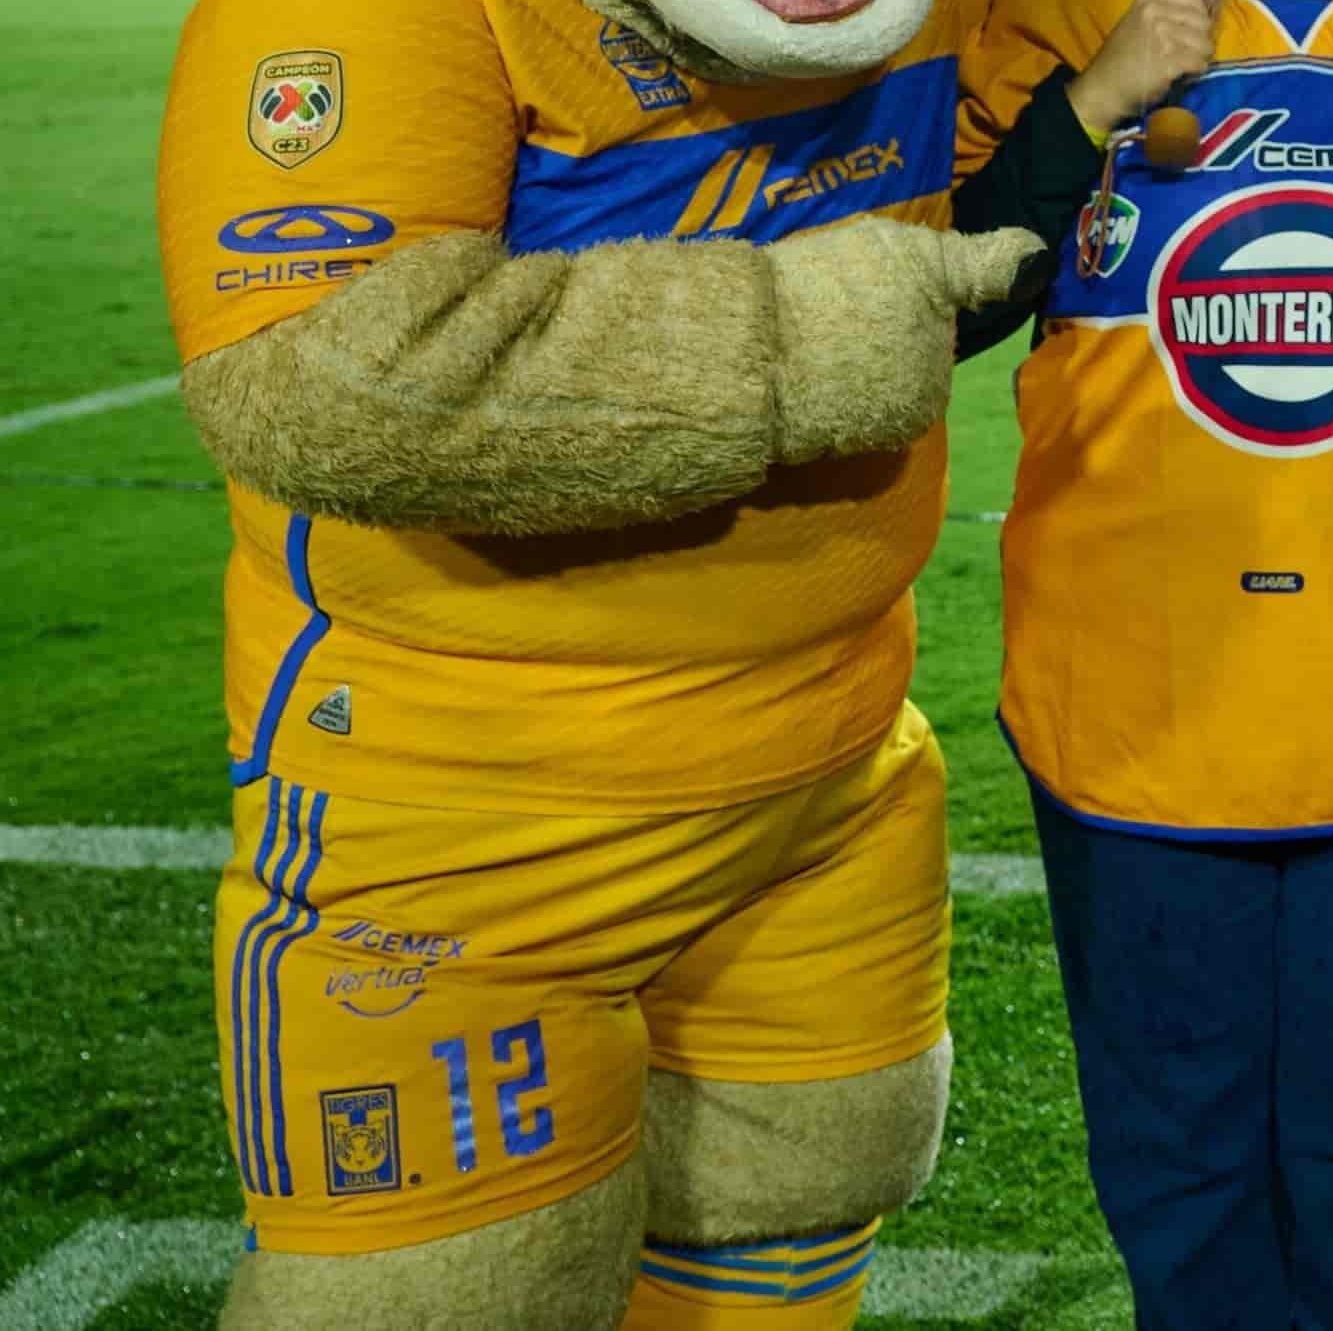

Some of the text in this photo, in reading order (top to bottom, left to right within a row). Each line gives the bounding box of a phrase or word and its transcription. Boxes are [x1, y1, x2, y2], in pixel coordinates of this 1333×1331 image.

[274, 138, 309, 153] C23
[362, 929, 467, 959] CEMEX
[431, 1018, 555, 1173] 12
